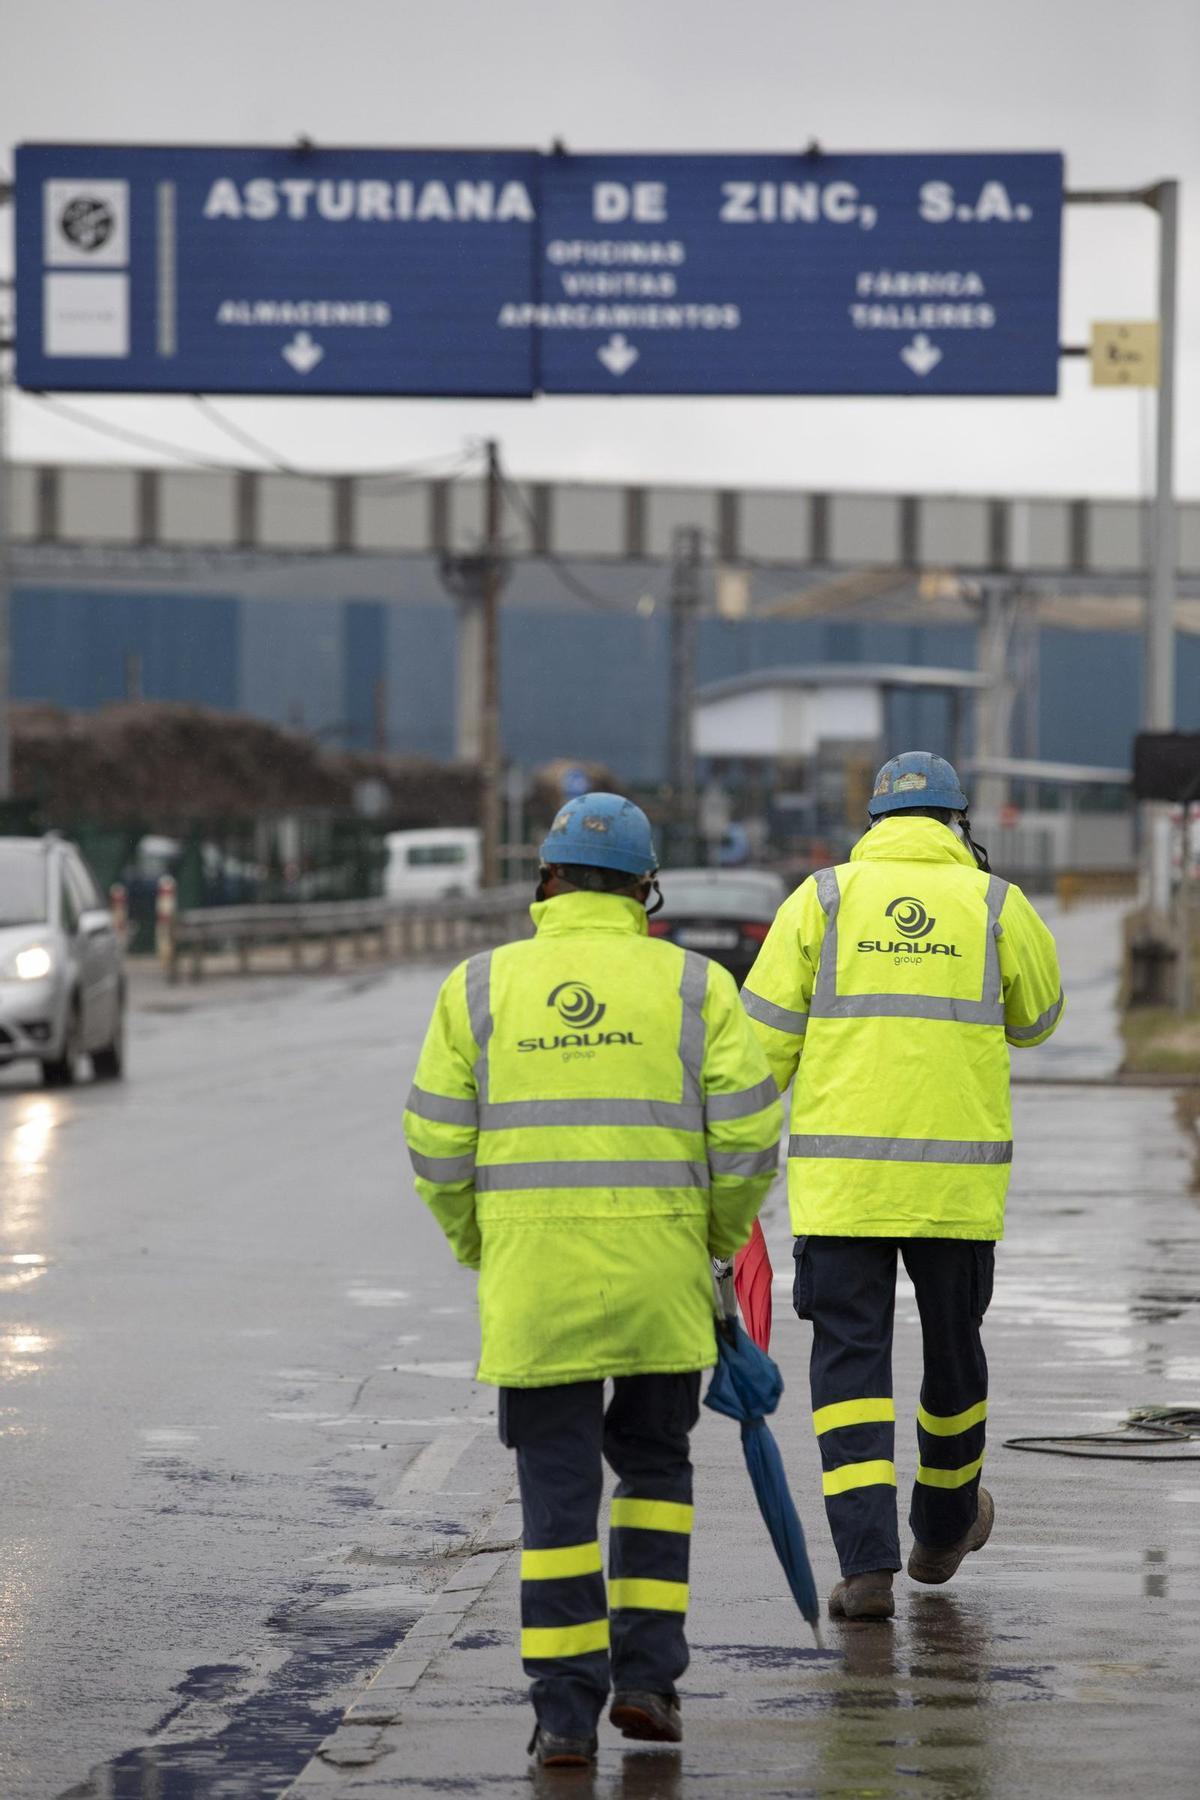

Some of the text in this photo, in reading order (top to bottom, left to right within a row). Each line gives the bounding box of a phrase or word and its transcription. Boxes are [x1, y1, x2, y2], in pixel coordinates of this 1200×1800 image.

[203, 178, 1032, 230] ASTURIANA DE ZINC, S.A.
[546, 239, 685, 266] OFICINAS
[561, 271, 677, 297] VISITAS
[216, 300, 393, 327] ALMACENES
[498, 303, 741, 330] APARCAMIENTOS
[849, 303, 995, 330] TALLERES
[857, 940, 962, 957] SUAVAL
[893, 956, 922, 966] group
[516, 1031, 643, 1053] SUAVAL
[561, 1050, 596, 1062] group
